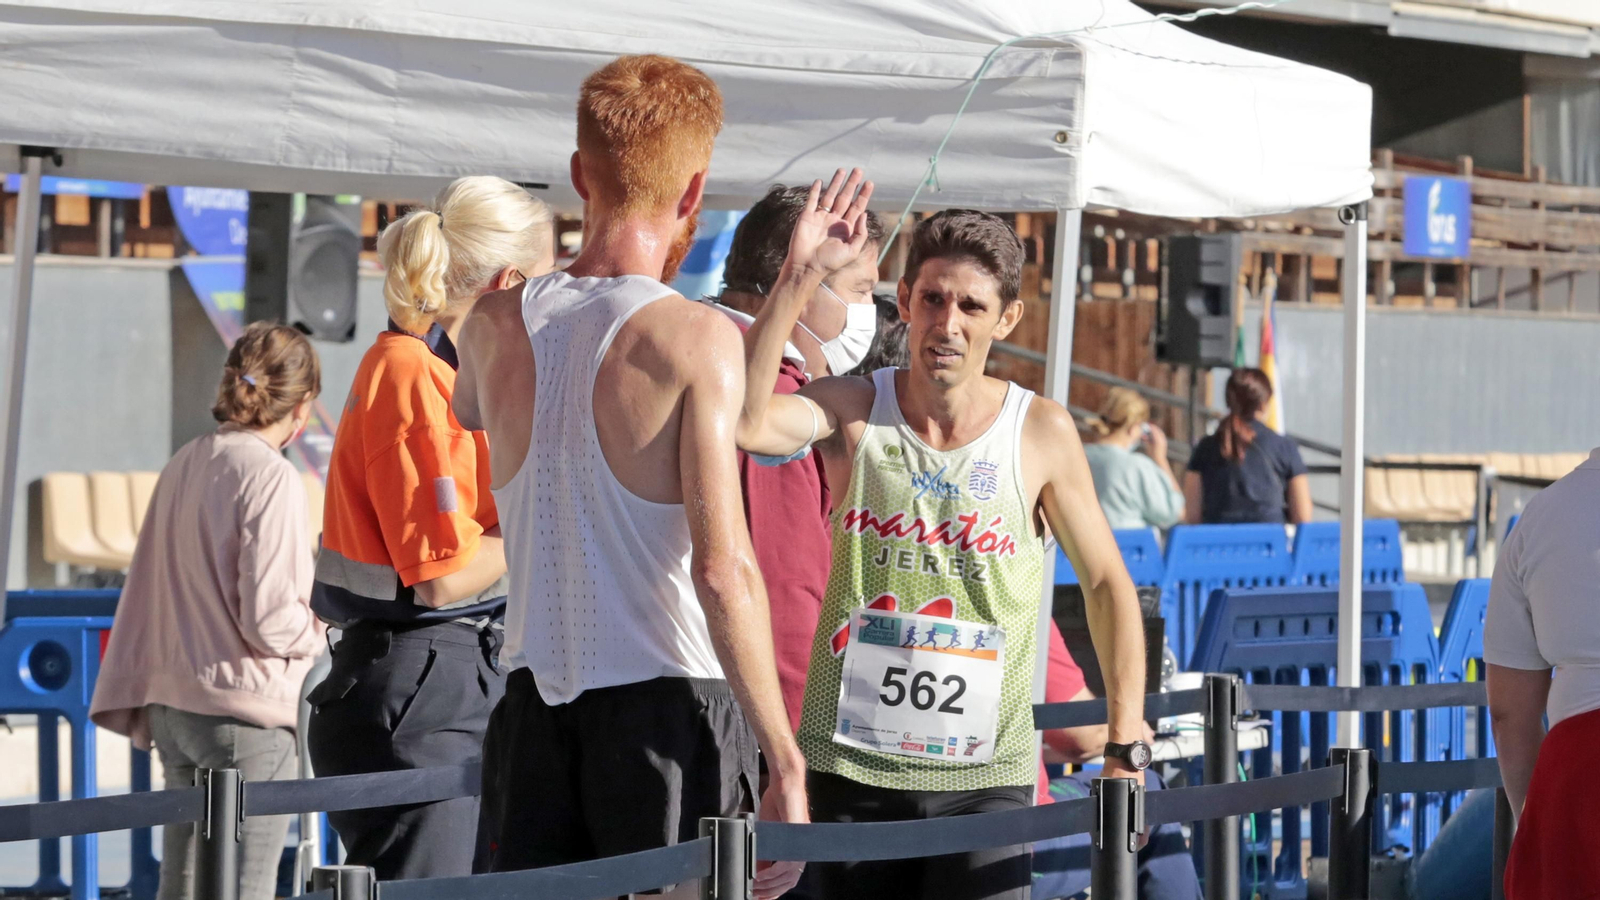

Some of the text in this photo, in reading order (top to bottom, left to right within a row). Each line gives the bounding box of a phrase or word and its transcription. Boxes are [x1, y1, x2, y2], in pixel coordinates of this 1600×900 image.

[843, 508, 1017, 556] maratón
[874, 547, 988, 583] JEREZ
[864, 627, 895, 636] Carrera
[866, 615, 895, 631] XLI
[863, 633, 895, 642] Popular
[879, 666, 967, 715] 562
